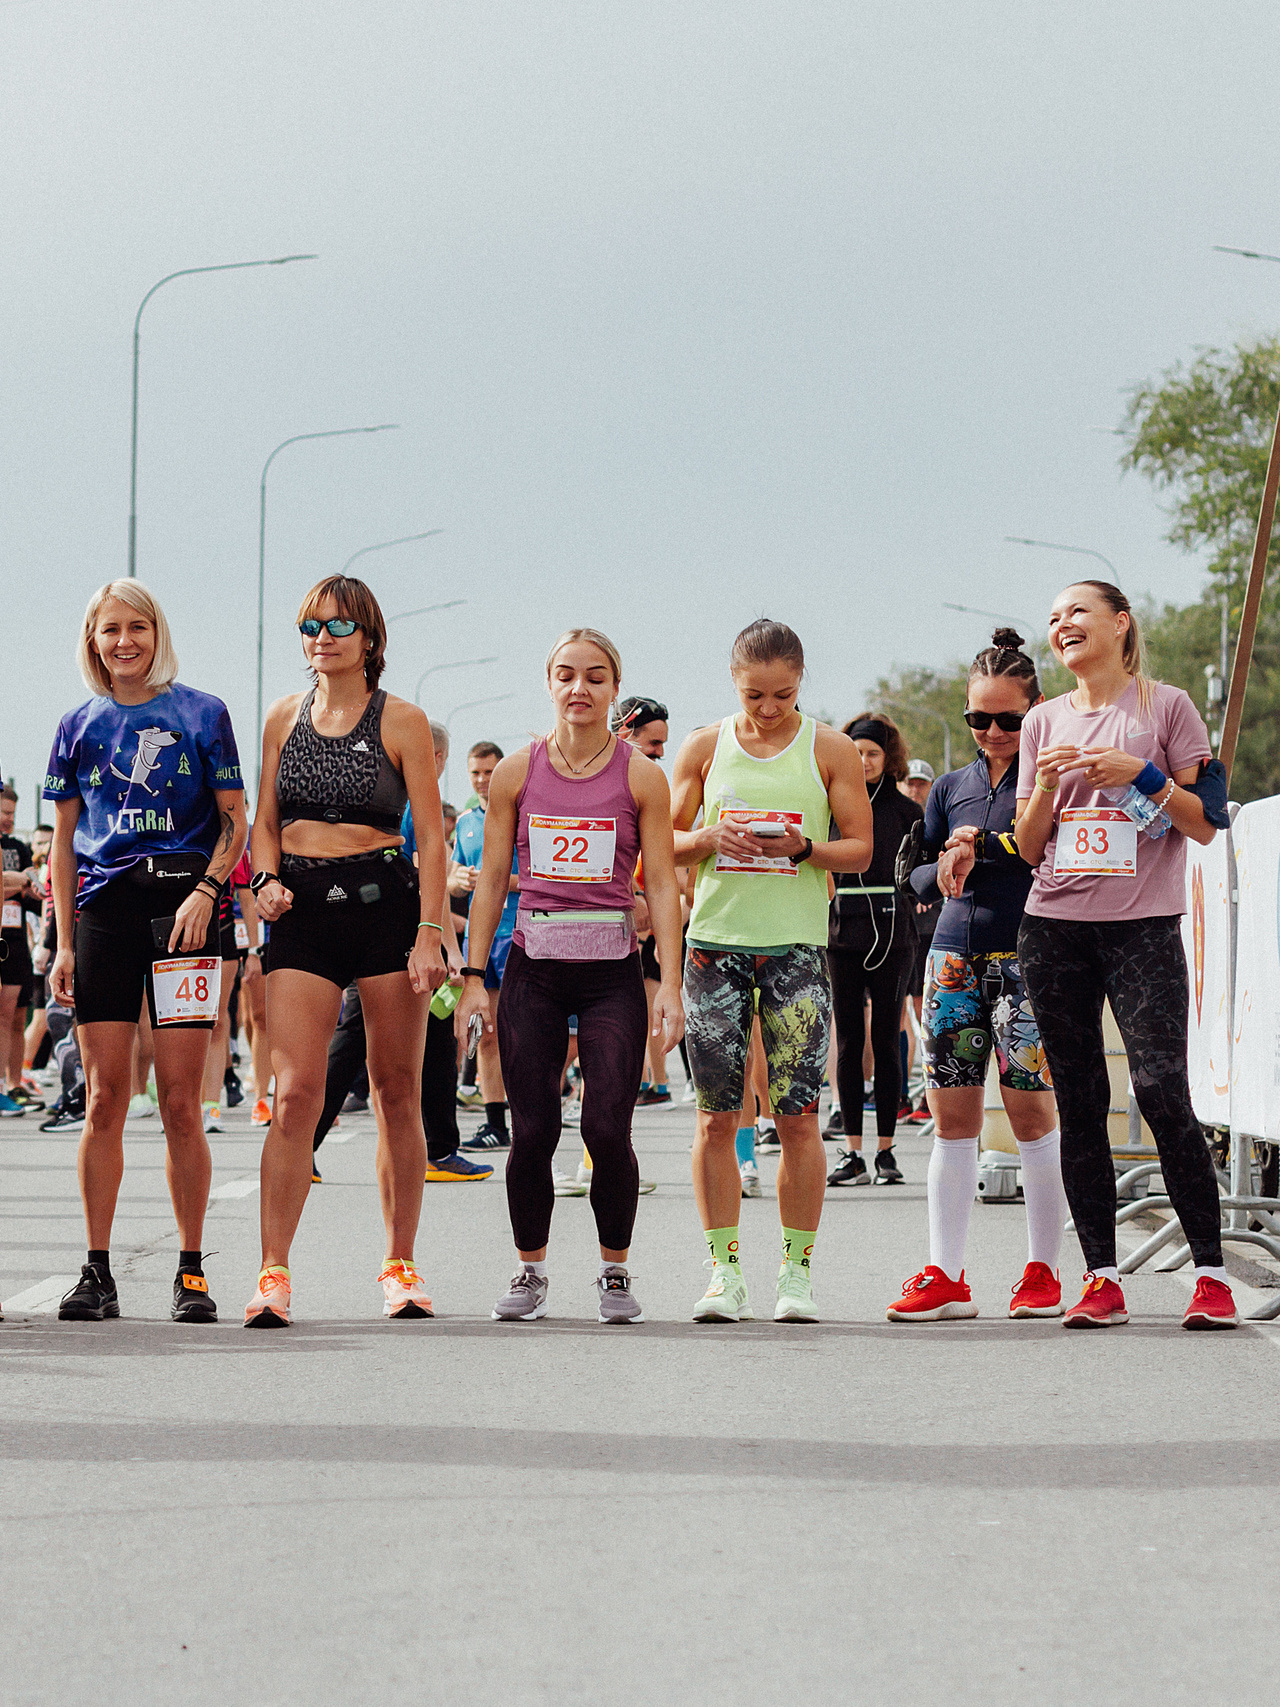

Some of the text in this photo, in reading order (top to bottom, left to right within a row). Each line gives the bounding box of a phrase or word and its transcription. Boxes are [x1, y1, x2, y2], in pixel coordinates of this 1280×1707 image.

[552, 835, 589, 863] 22
[1075, 827, 1110, 855] 83
[174, 975, 209, 1002] 48
